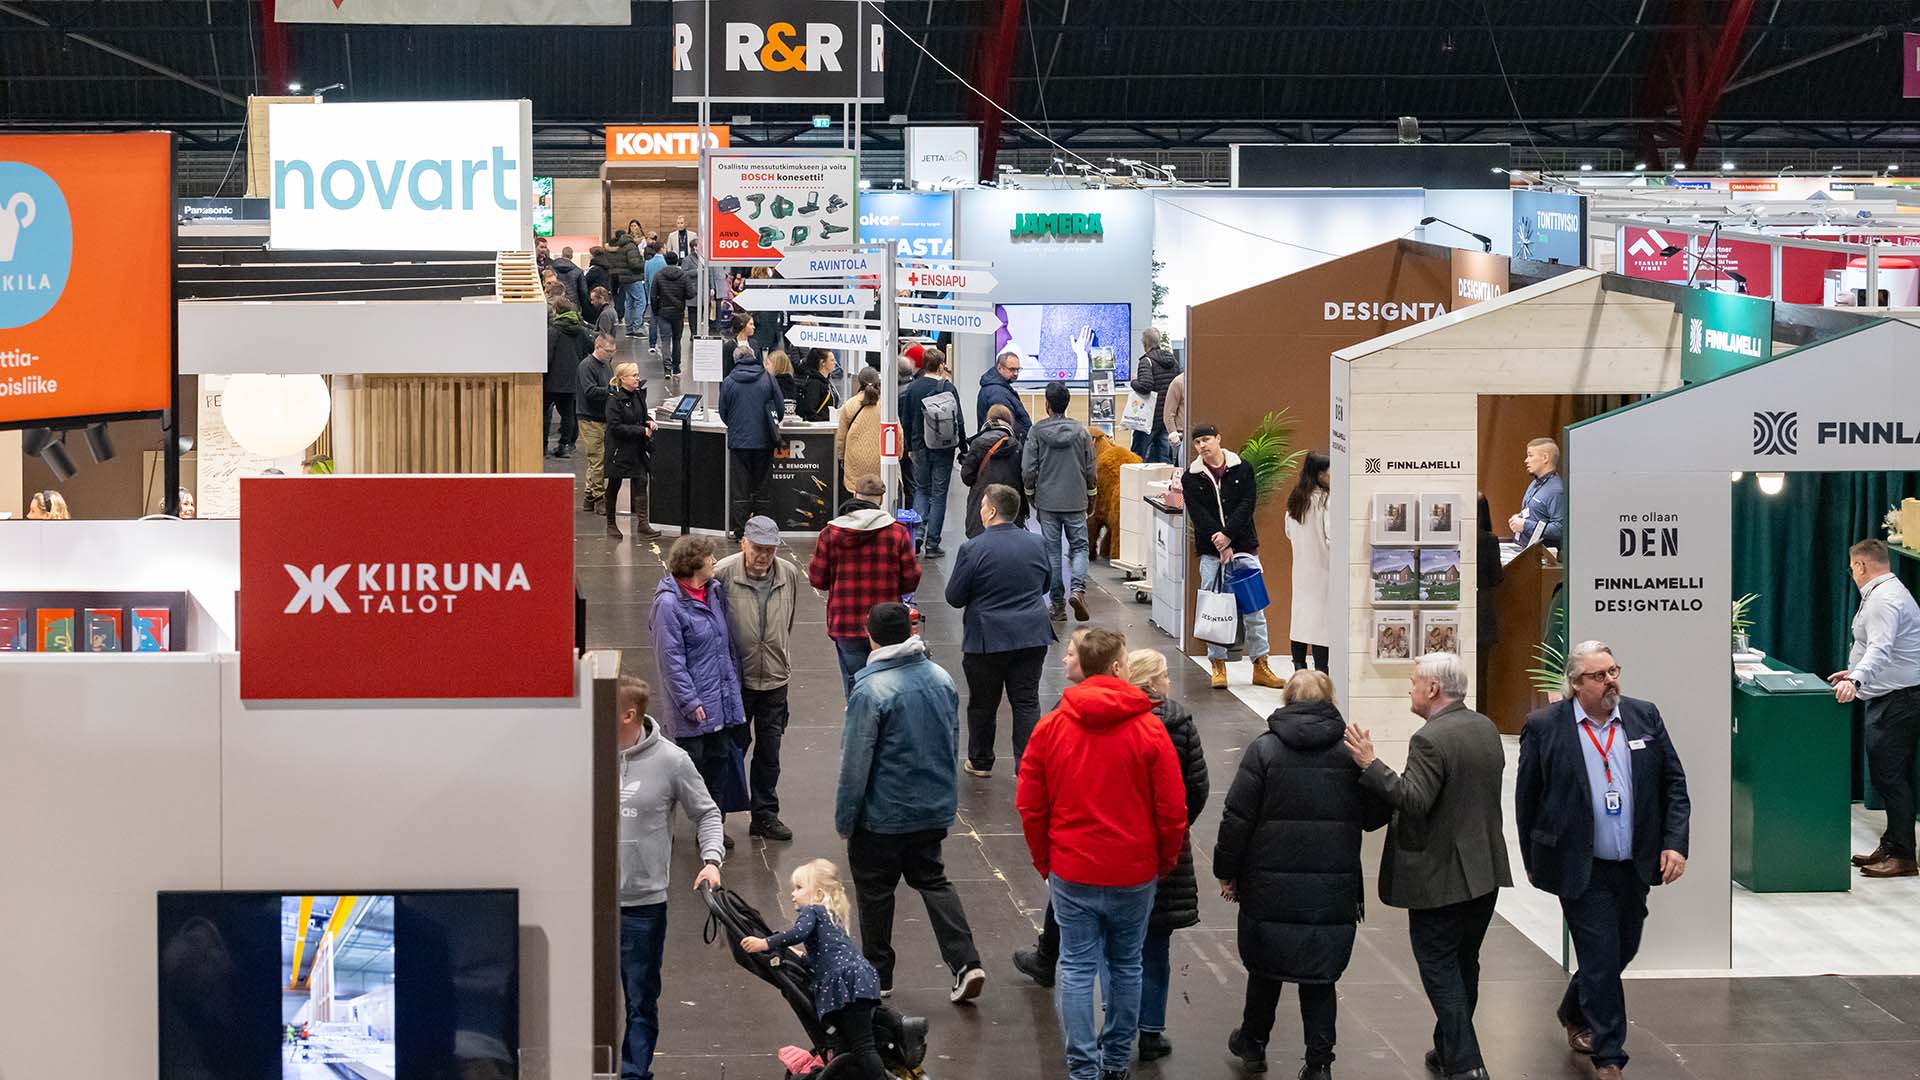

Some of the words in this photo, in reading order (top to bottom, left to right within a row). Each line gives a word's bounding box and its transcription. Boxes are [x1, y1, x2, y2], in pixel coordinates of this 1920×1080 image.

[726, 22, 843, 72] R&R
[821, 163, 828, 171] ja
[275, 146, 517, 211] novart
[741, 173, 774, 181] BOSCH
[777, 173, 824, 182] konesetti!
[184, 206, 233, 214] Panasonic
[719, 240, 738, 248] 800
[741, 240, 749, 248] €
[810, 259, 868, 271] RAVINTOLA
[921, 274, 967, 288] ENSIAPU
[789, 294, 856, 305] MUKSULA
[911, 313, 982, 328] LASTENHOITO
[800, 330, 868, 345] OHJELMALAVA
[1705, 328, 1761, 358] FINNLAMELLI
[1818, 422, 1920, 444] FINNL
[1387, 461, 1460, 470] FINNLAMELLI
[1619, 513, 1638, 522] me
[1641, 511, 1679, 523] ollaan
[1619, 528, 1679, 557] DEN
[358, 563, 531, 591] KIIRUNA
[1594, 577, 1704, 590] FINNLAMELLI
[359, 595, 458, 613] TALOT
